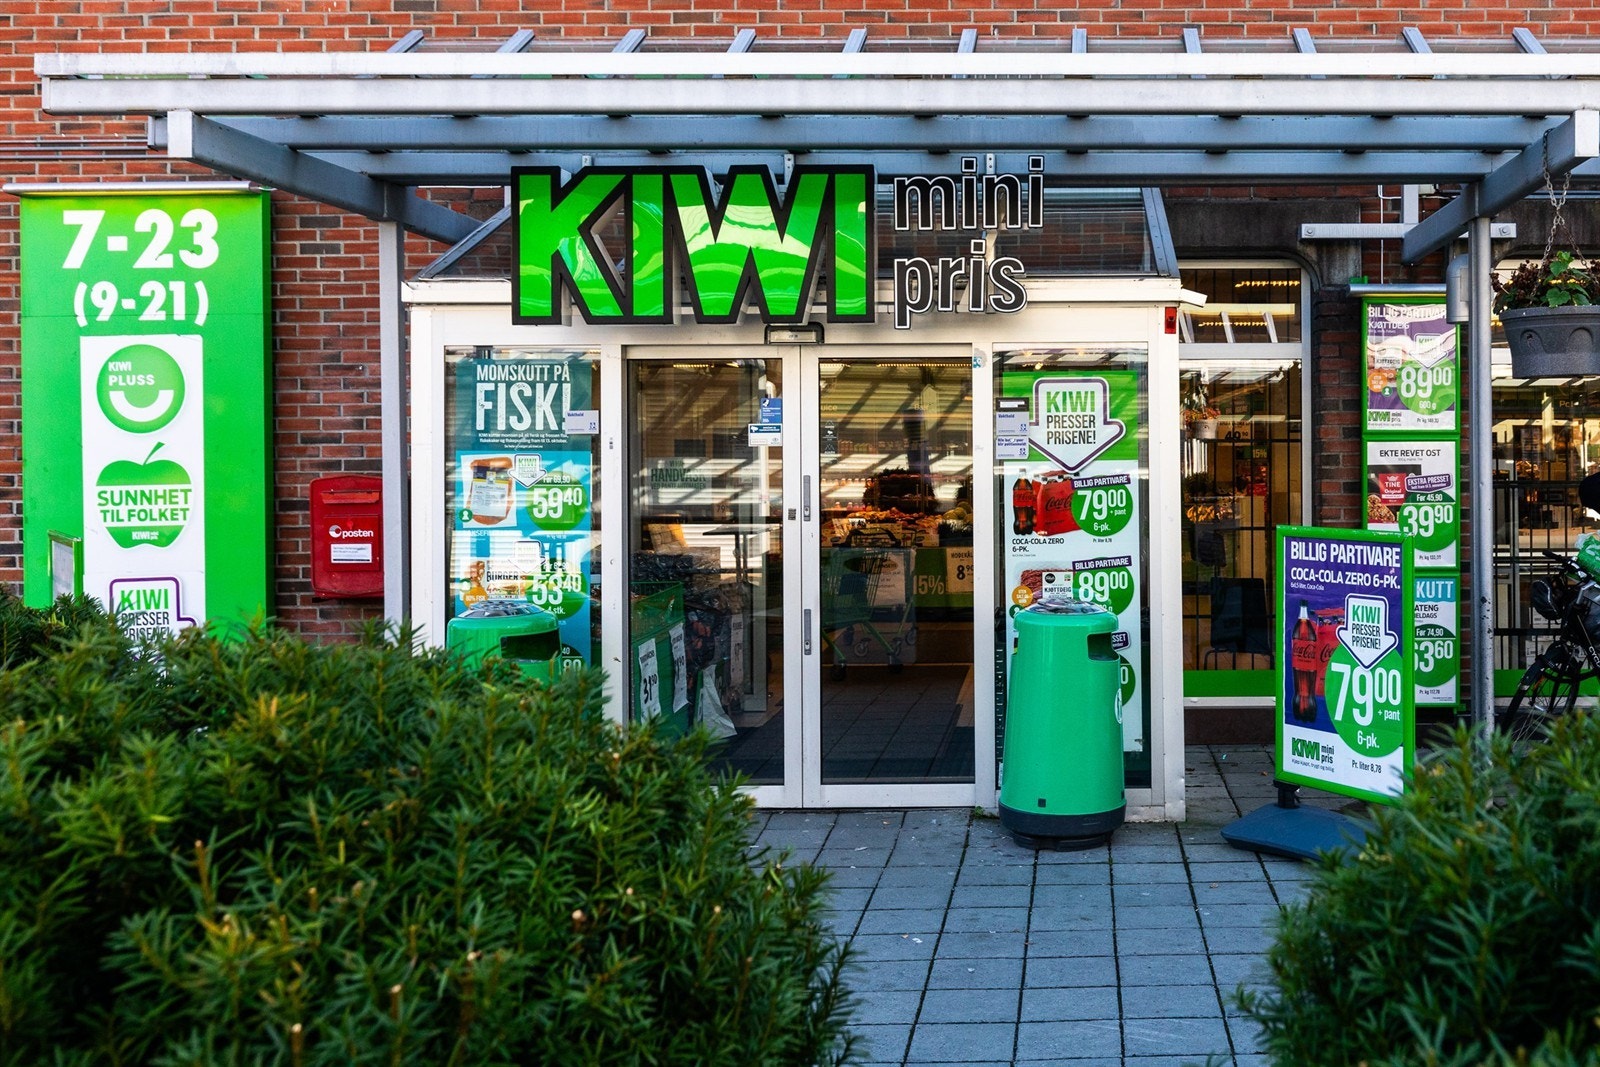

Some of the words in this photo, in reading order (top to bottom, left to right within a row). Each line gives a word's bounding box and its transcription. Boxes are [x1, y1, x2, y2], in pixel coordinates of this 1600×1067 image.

[893, 155, 1044, 232] mini
[511, 164, 877, 326] KIWI
[893, 238, 1029, 330] pris
[73, 280, 209, 327] (9-21)
[108, 361, 132, 372] KIWI
[476, 364, 550, 381] MOMSKUTT
[553, 360, 570, 381] PÅ
[108, 374, 155, 386] PLUSS
[476, 382, 571, 431] FISK!
[1046, 390, 1096, 413] KIWI
[1046, 414, 1096, 429] PRESSER
[1046, 430, 1096, 445] PRISENE!
[1379, 449, 1399, 457] EKTE
[1400, 449, 1425, 457] REVET
[1425, 449, 1441, 457] OST
[1074, 477, 1094, 488] BILLIG
[1095, 475, 1129, 487] PARTIVARE
[1407, 477, 1427, 486] EKSTRA
[1427, 475, 1449, 484] PRESSET
[97, 488, 192, 506] SUNNHET
[1426, 493, 1443, 503] 45,90
[100, 509, 125, 523] TIL
[127, 507, 190, 522] FOLKET
[1114, 508, 1127, 516] pant
[342, 529, 374, 539] posten
[1093, 522, 1111, 532] 6-pk.
[1290, 541, 1327, 562] BILLIG
[1330, 543, 1401, 568] PARTIVARE
[1075, 561, 1095, 570] BILLIG
[1095, 558, 1129, 569] PARTIVARE
[912, 575, 945, 595] 15%
[1290, 567, 1344, 584] COCA-COLA
[1345, 571, 1371, 587] ZERO
[1373, 574, 1401, 590] 6-PK.
[121, 588, 169, 611] KIWI
[1352, 604, 1381, 625] KIWI
[1352, 623, 1381, 637] PRESSER
[1427, 628, 1444, 637] 74,90
[1352, 635, 1381, 650] PRISENE!
[1384, 709, 1401, 721] pant
[1357, 730, 1380, 749] 6-pk.
[1291, 737, 1320, 761] KIWI
[1321, 743, 1335, 755] mini
[1321, 753, 1334, 764] pris
[1359, 761, 1370, 771] liter
[1370, 763, 1382, 774] 8,78
